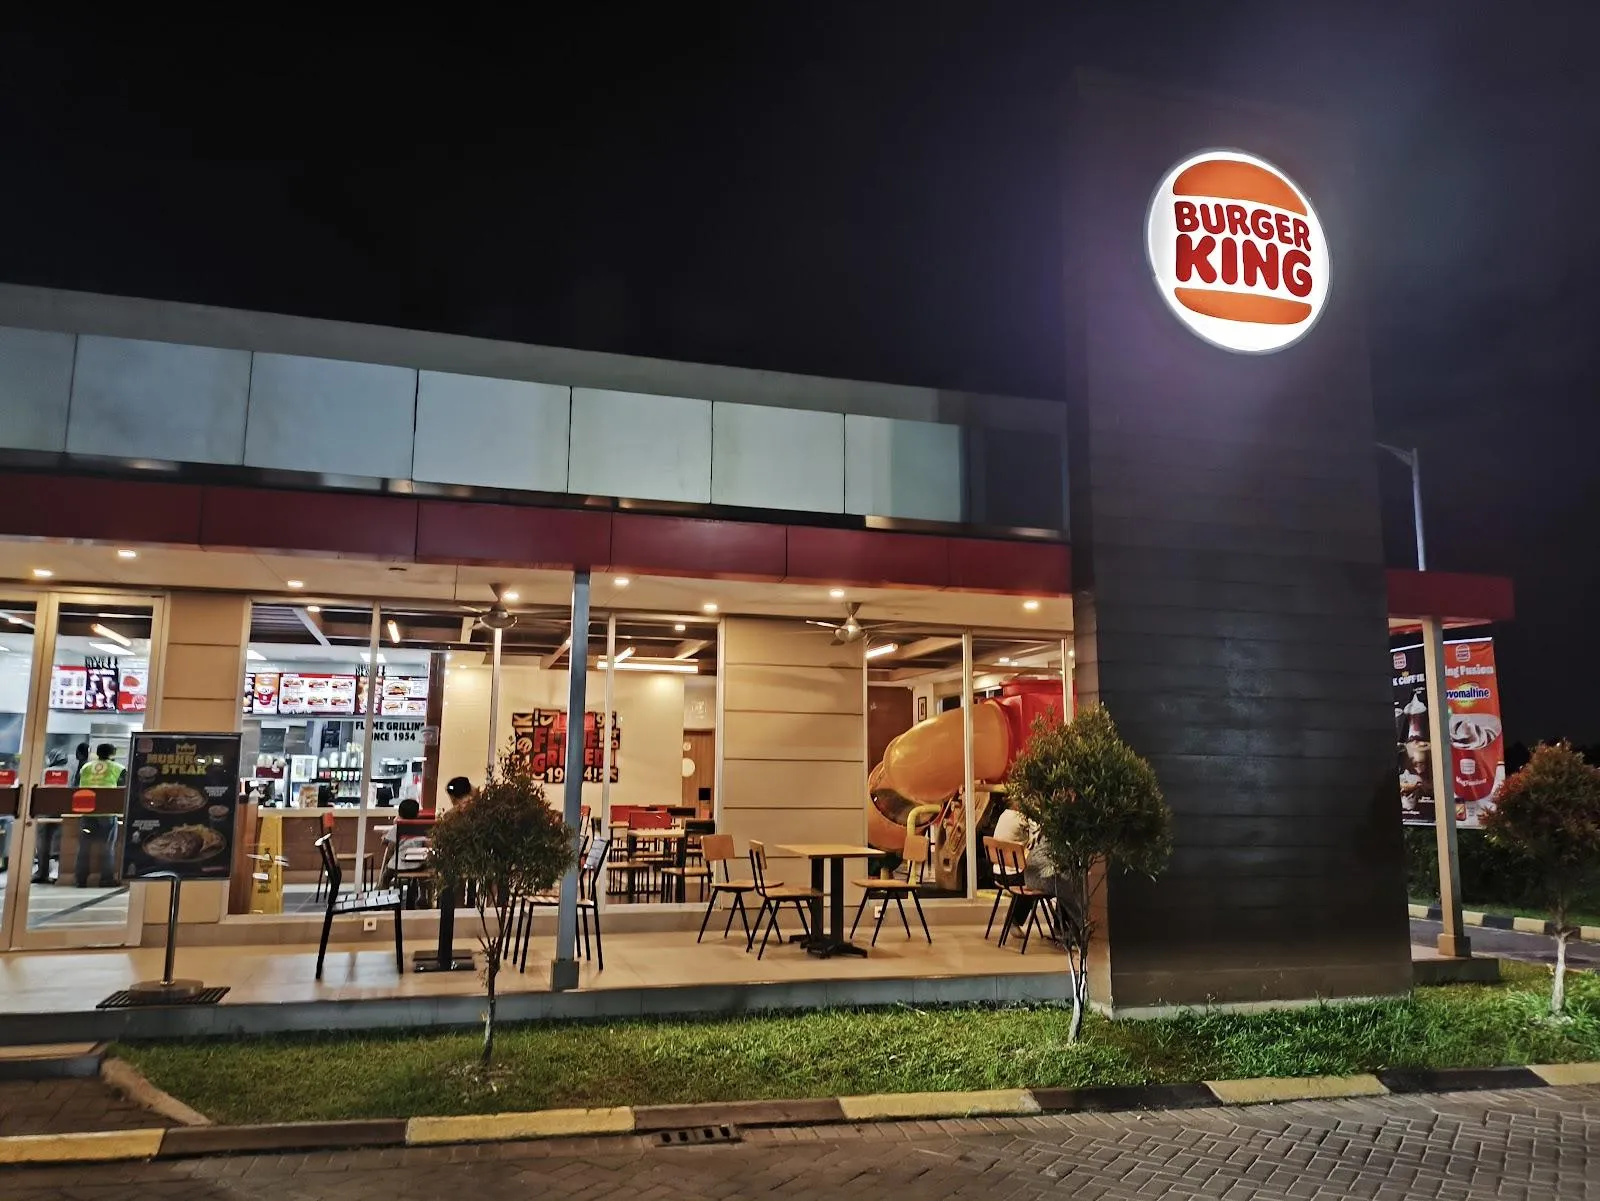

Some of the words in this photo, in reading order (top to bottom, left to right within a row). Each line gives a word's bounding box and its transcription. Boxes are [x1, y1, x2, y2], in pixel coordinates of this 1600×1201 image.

[1174, 201, 1312, 251] BURGER
[1175, 233, 1313, 297] KING
[1445, 664, 1460, 678] ing
[355, 721, 385, 730] FLME
[371, 732, 390, 741] INCE
[394, 732, 416, 741] 1954
[532, 747, 604, 773] GRIED
[161, 764, 207, 776] STEAK
[546, 766, 598, 783] 194!
